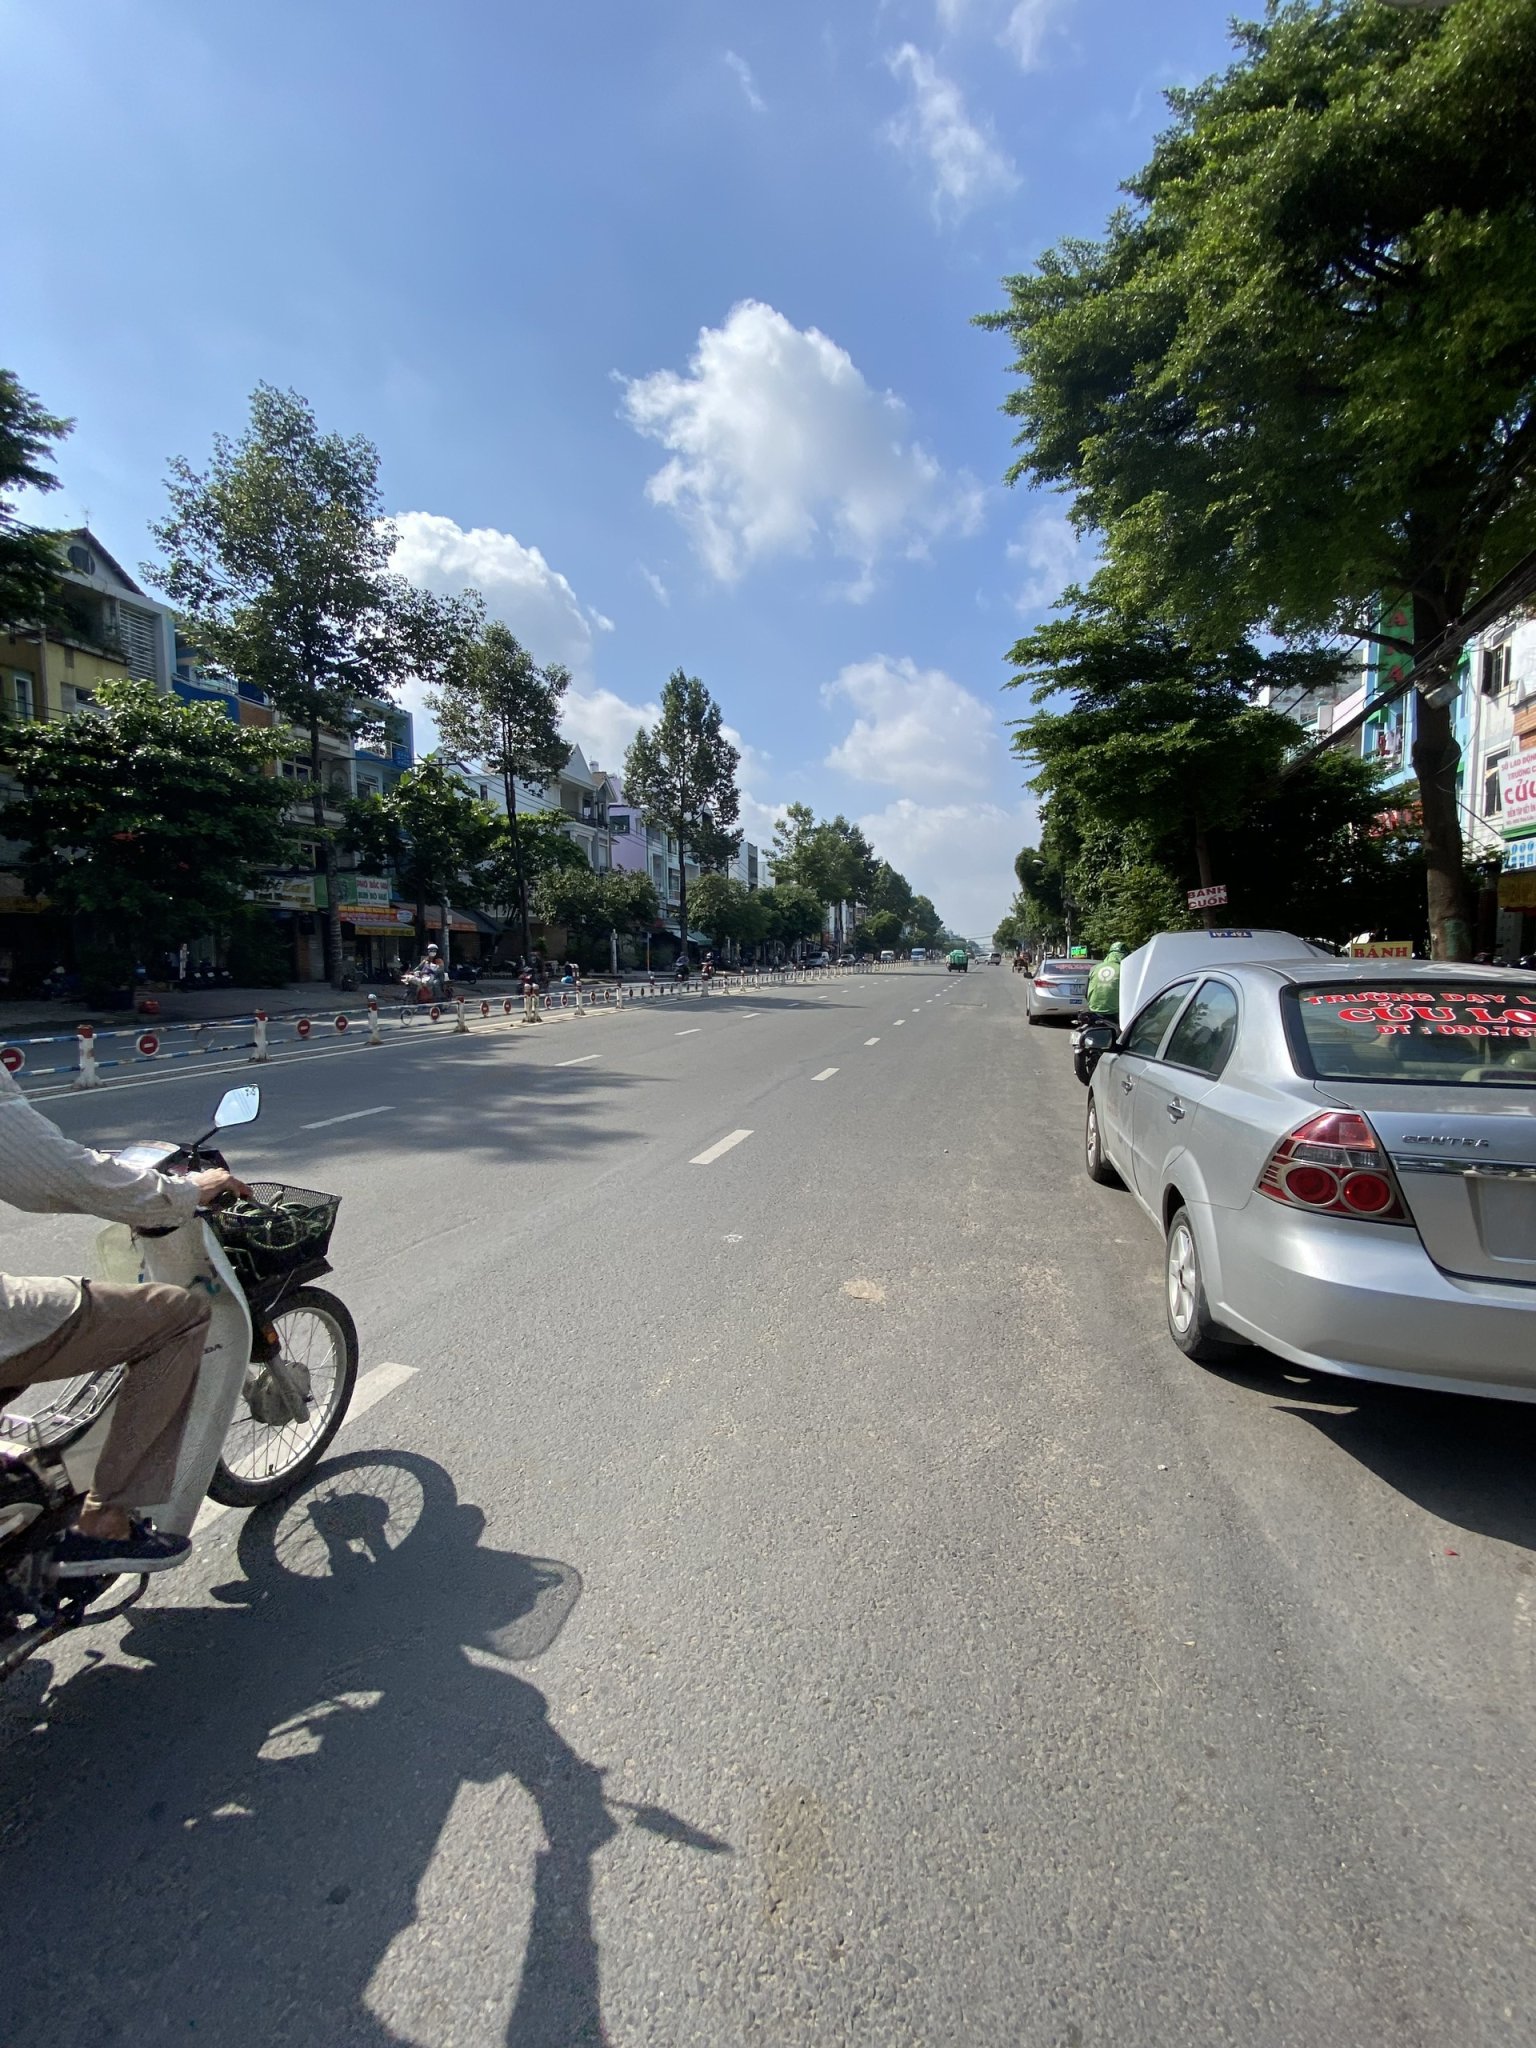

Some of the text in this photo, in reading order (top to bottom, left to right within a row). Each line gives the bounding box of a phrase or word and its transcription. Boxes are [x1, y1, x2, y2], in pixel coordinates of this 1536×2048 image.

[1354, 945, 1408, 958] BÁNH
[1440, 993, 1506, 1004] DẠY
[1337, 1001, 1457, 1023] CỬU
